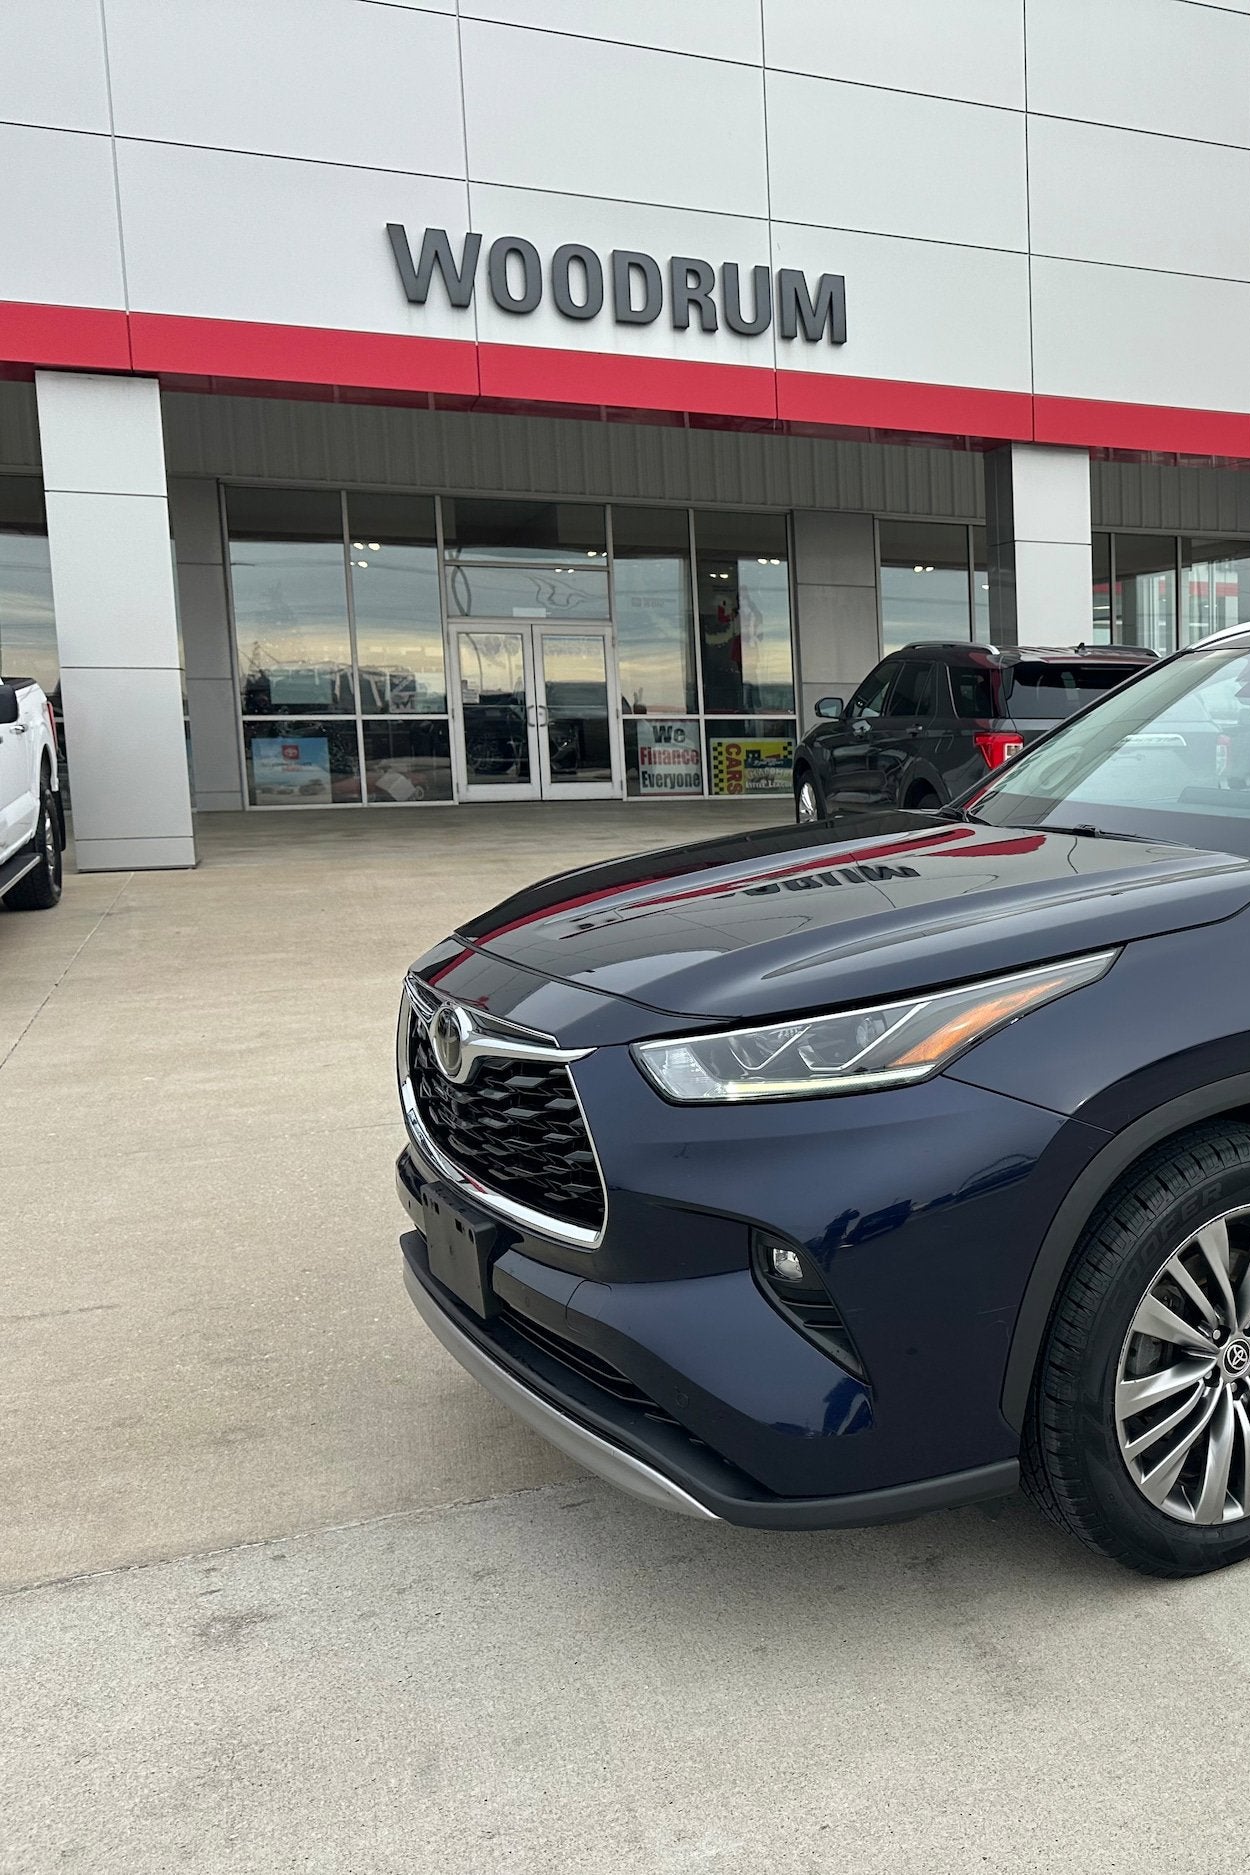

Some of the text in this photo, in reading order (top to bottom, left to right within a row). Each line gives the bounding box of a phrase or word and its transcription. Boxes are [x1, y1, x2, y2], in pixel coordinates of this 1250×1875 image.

[386, 223, 847, 345] WOODRUM
[653, 725, 686, 743] We
[640, 746, 699, 765] Finance
[726, 743, 743, 795] CARS
[641, 770, 700, 790] Everyone
